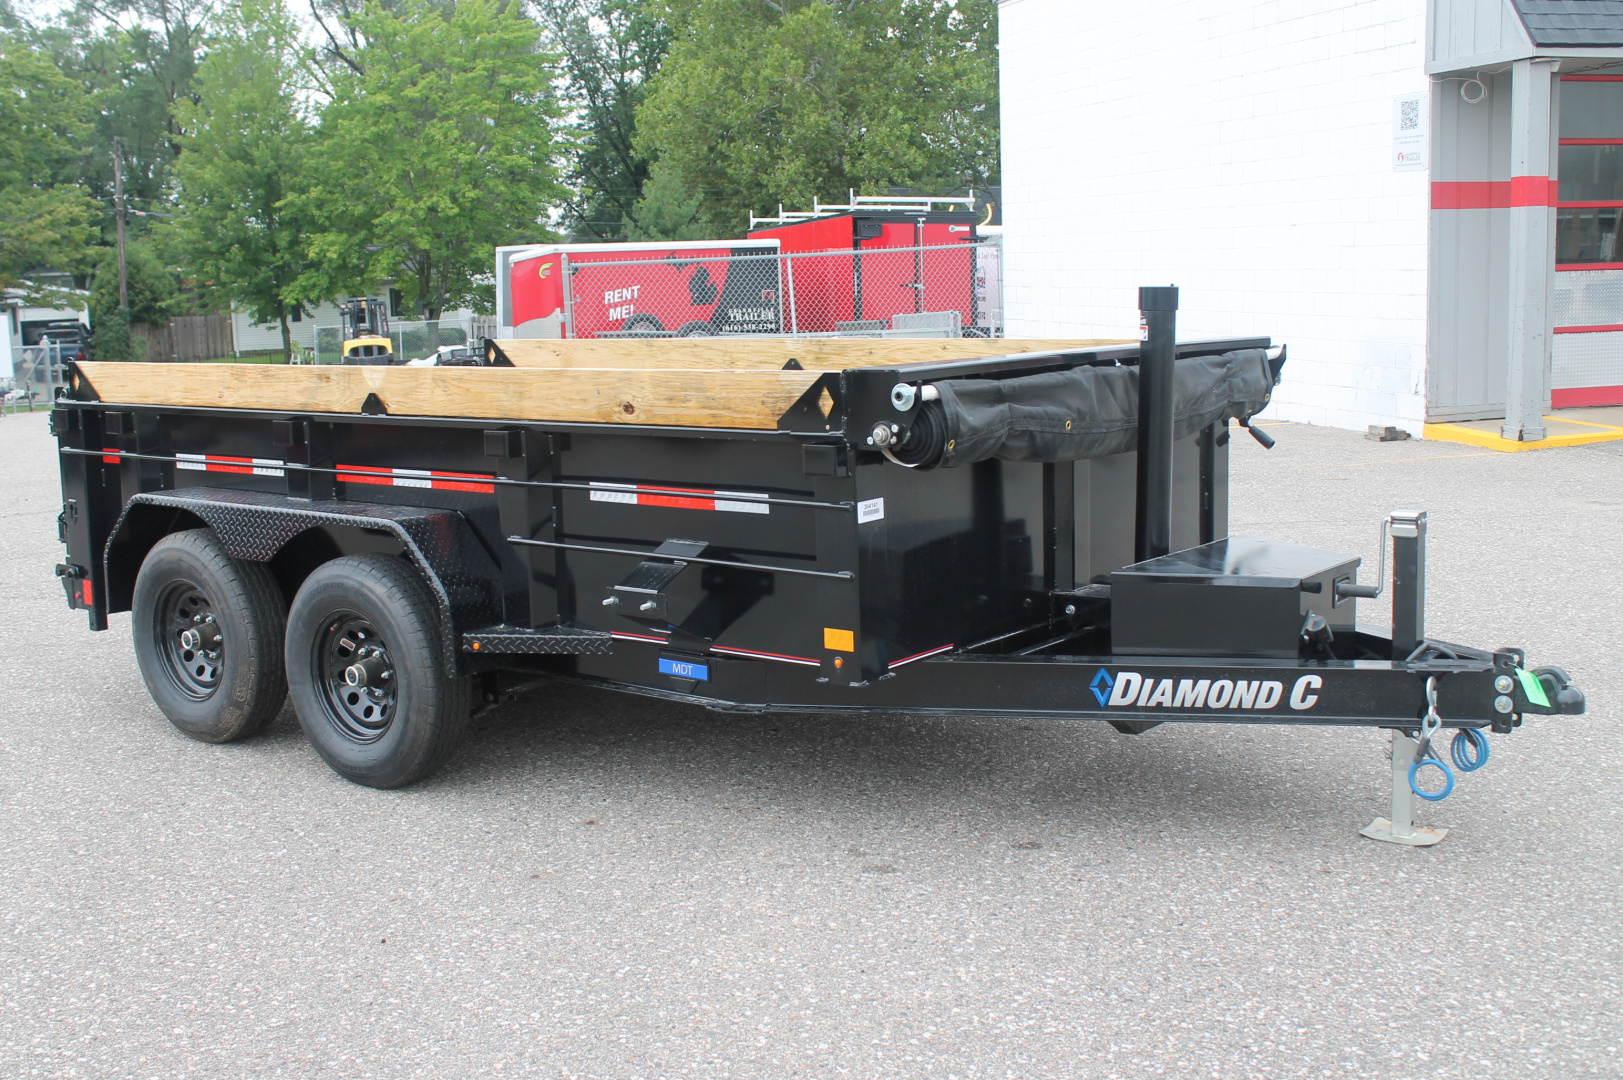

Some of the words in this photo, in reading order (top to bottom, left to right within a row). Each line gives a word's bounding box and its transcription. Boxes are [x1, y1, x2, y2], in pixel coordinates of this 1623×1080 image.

[604, 285, 640, 304] RENT
[609, 304, 634, 321] ME!
[730, 312, 775, 321] TRAILER
[672, 663, 693, 675] MDT
[1108, 671, 1284, 710] DIAMOND
[1289, 674, 1323, 711] C
